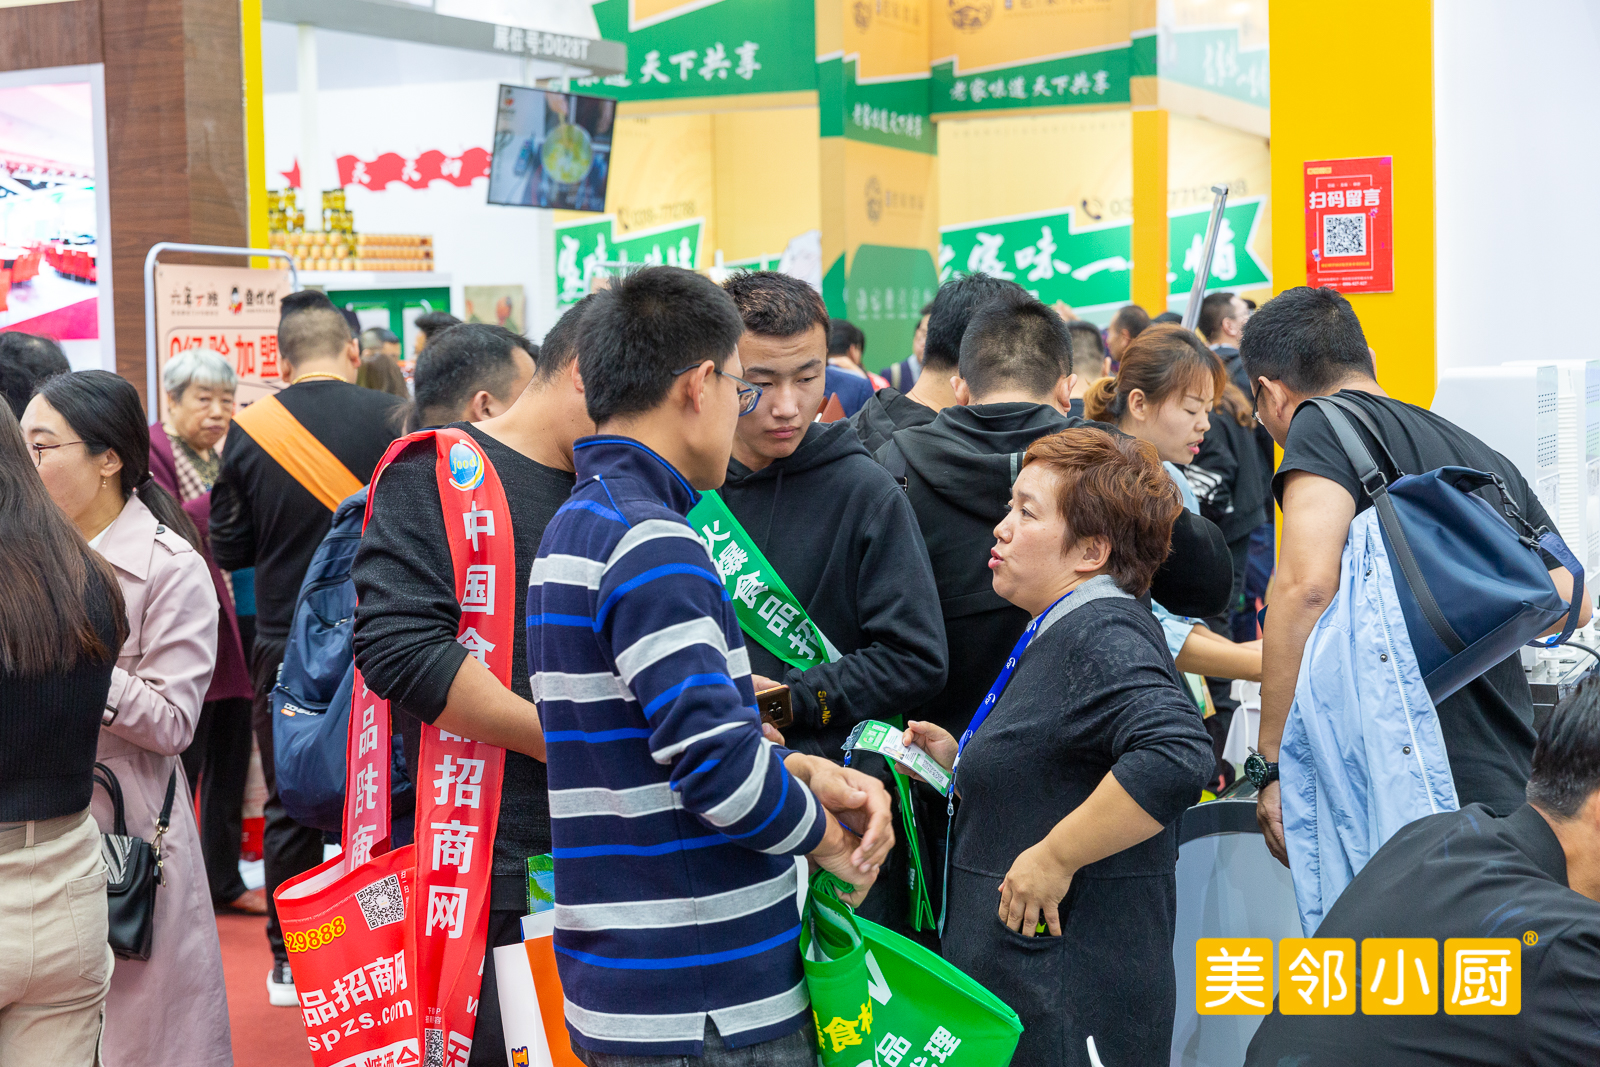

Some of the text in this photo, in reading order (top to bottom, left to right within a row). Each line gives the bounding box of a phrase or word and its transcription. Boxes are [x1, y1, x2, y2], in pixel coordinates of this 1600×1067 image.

[639, 40, 762, 84] 天下共享
[1308, 188, 1381, 209] 扫码留言
